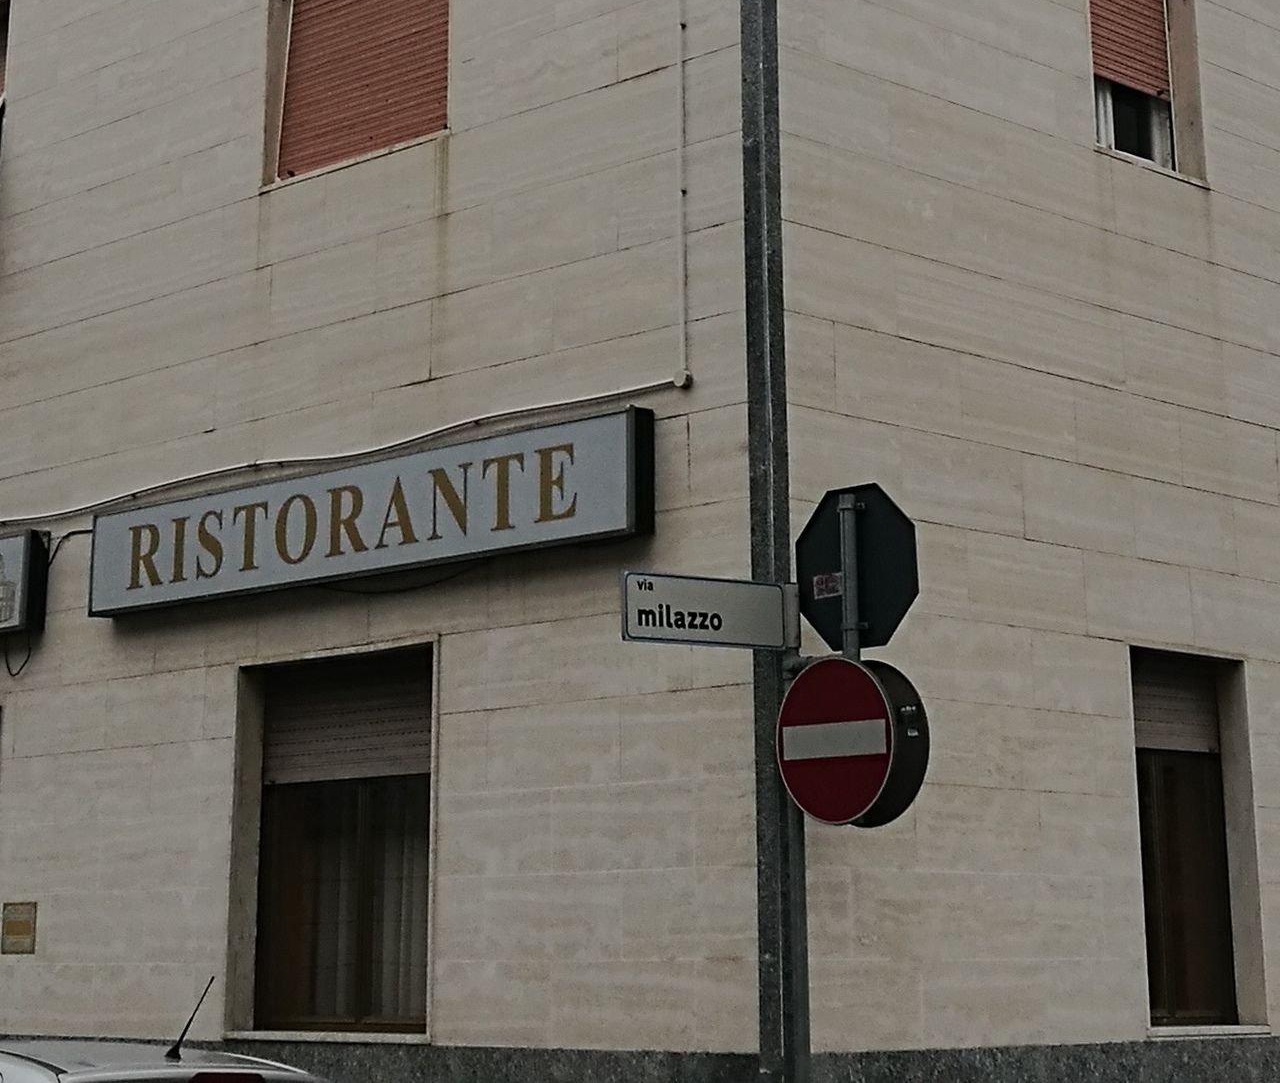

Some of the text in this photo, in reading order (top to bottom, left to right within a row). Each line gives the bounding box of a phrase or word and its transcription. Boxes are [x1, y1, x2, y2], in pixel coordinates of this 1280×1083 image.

[126, 442, 578, 590] RISTORANTE
[636, 578, 654, 591] via
[637, 603, 723, 631] milazzo
